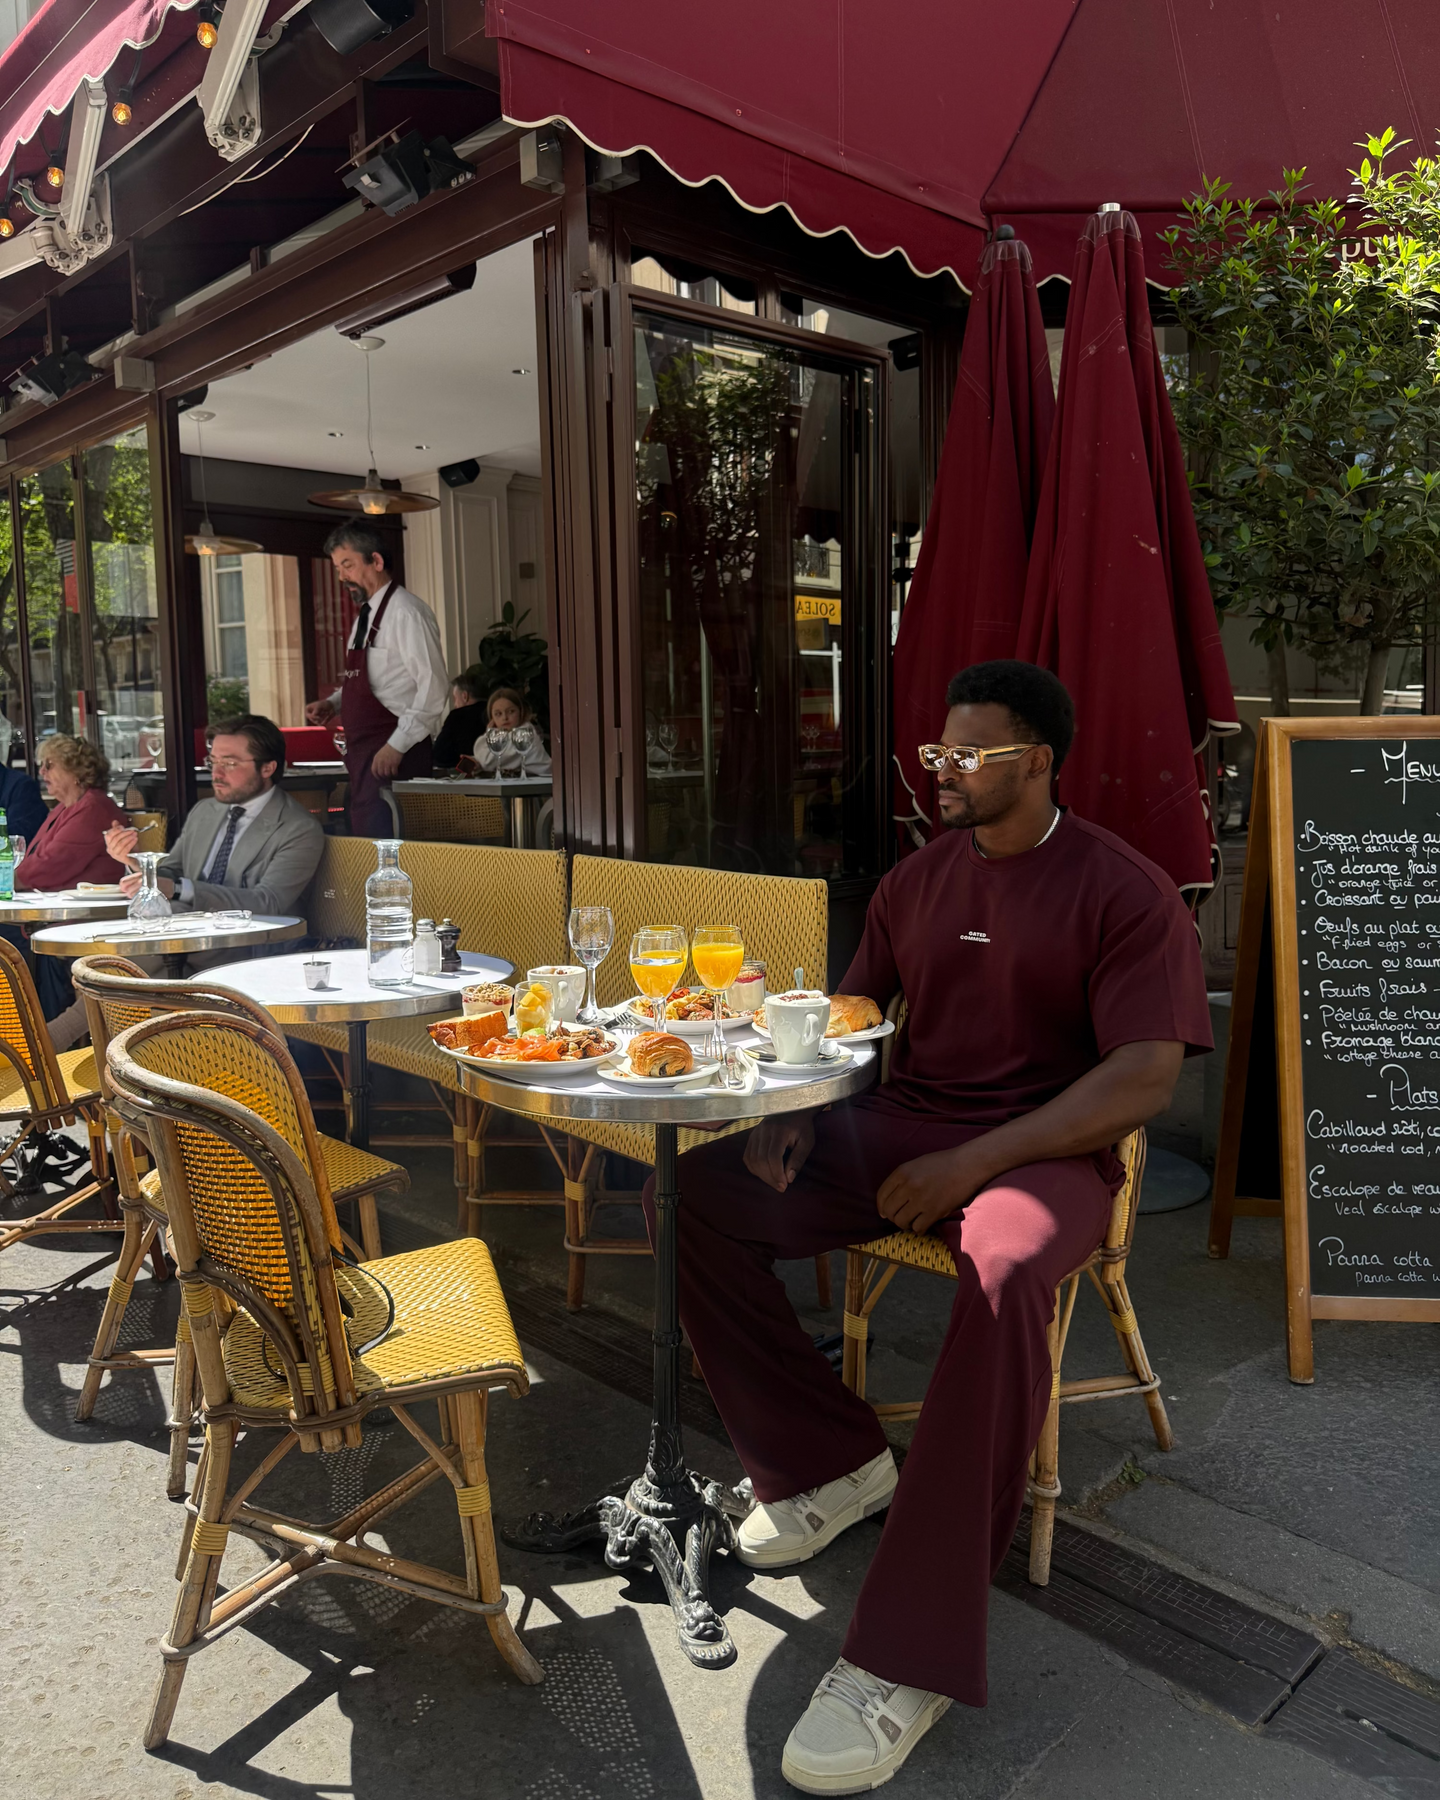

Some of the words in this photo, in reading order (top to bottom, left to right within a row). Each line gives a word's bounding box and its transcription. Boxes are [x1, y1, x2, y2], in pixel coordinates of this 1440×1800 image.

[1361, 829, 1419, 845] chaude
[1405, 844, 1417, 858] of
[1422, 846, 1440, 859] yo
[1311, 860, 1335, 888] Jus
[1406, 859, 1437, 880] frais
[1389, 894, 1408, 905] ou
[1414, 889, 1440, 909] pai
[1363, 924, 1386, 934] au
[1389, 920, 1420, 940] plat
[1377, 940, 1407, 953] eggs
[1417, 942, 1432, 950] or
[1316, 951, 1373, 971] Bacon
[1381, 958, 1400, 969] ou
[1319, 979, 1371, 999] Fruits
[1378, 977, 1428, 1003] frais
[1378, 1006, 1399, 1021] de
[1321, 1031, 1396, 1054] Fromage
[1380, 1063, 1439, 1105] Plats
[1306, 1109, 1387, 1139] Cabillaud
[1309, 1164, 1381, 1200] Escalope
[1387, 1180, 1408, 1196] de
[1334, 1200, 1366, 1216] Veal
[1372, 1202, 1423, 1218] escalope
[1318, 1236, 1385, 1267] Panna
[1393, 1250, 1434, 1267] cotta
[1397, 1271, 1427, 1283] cotta
